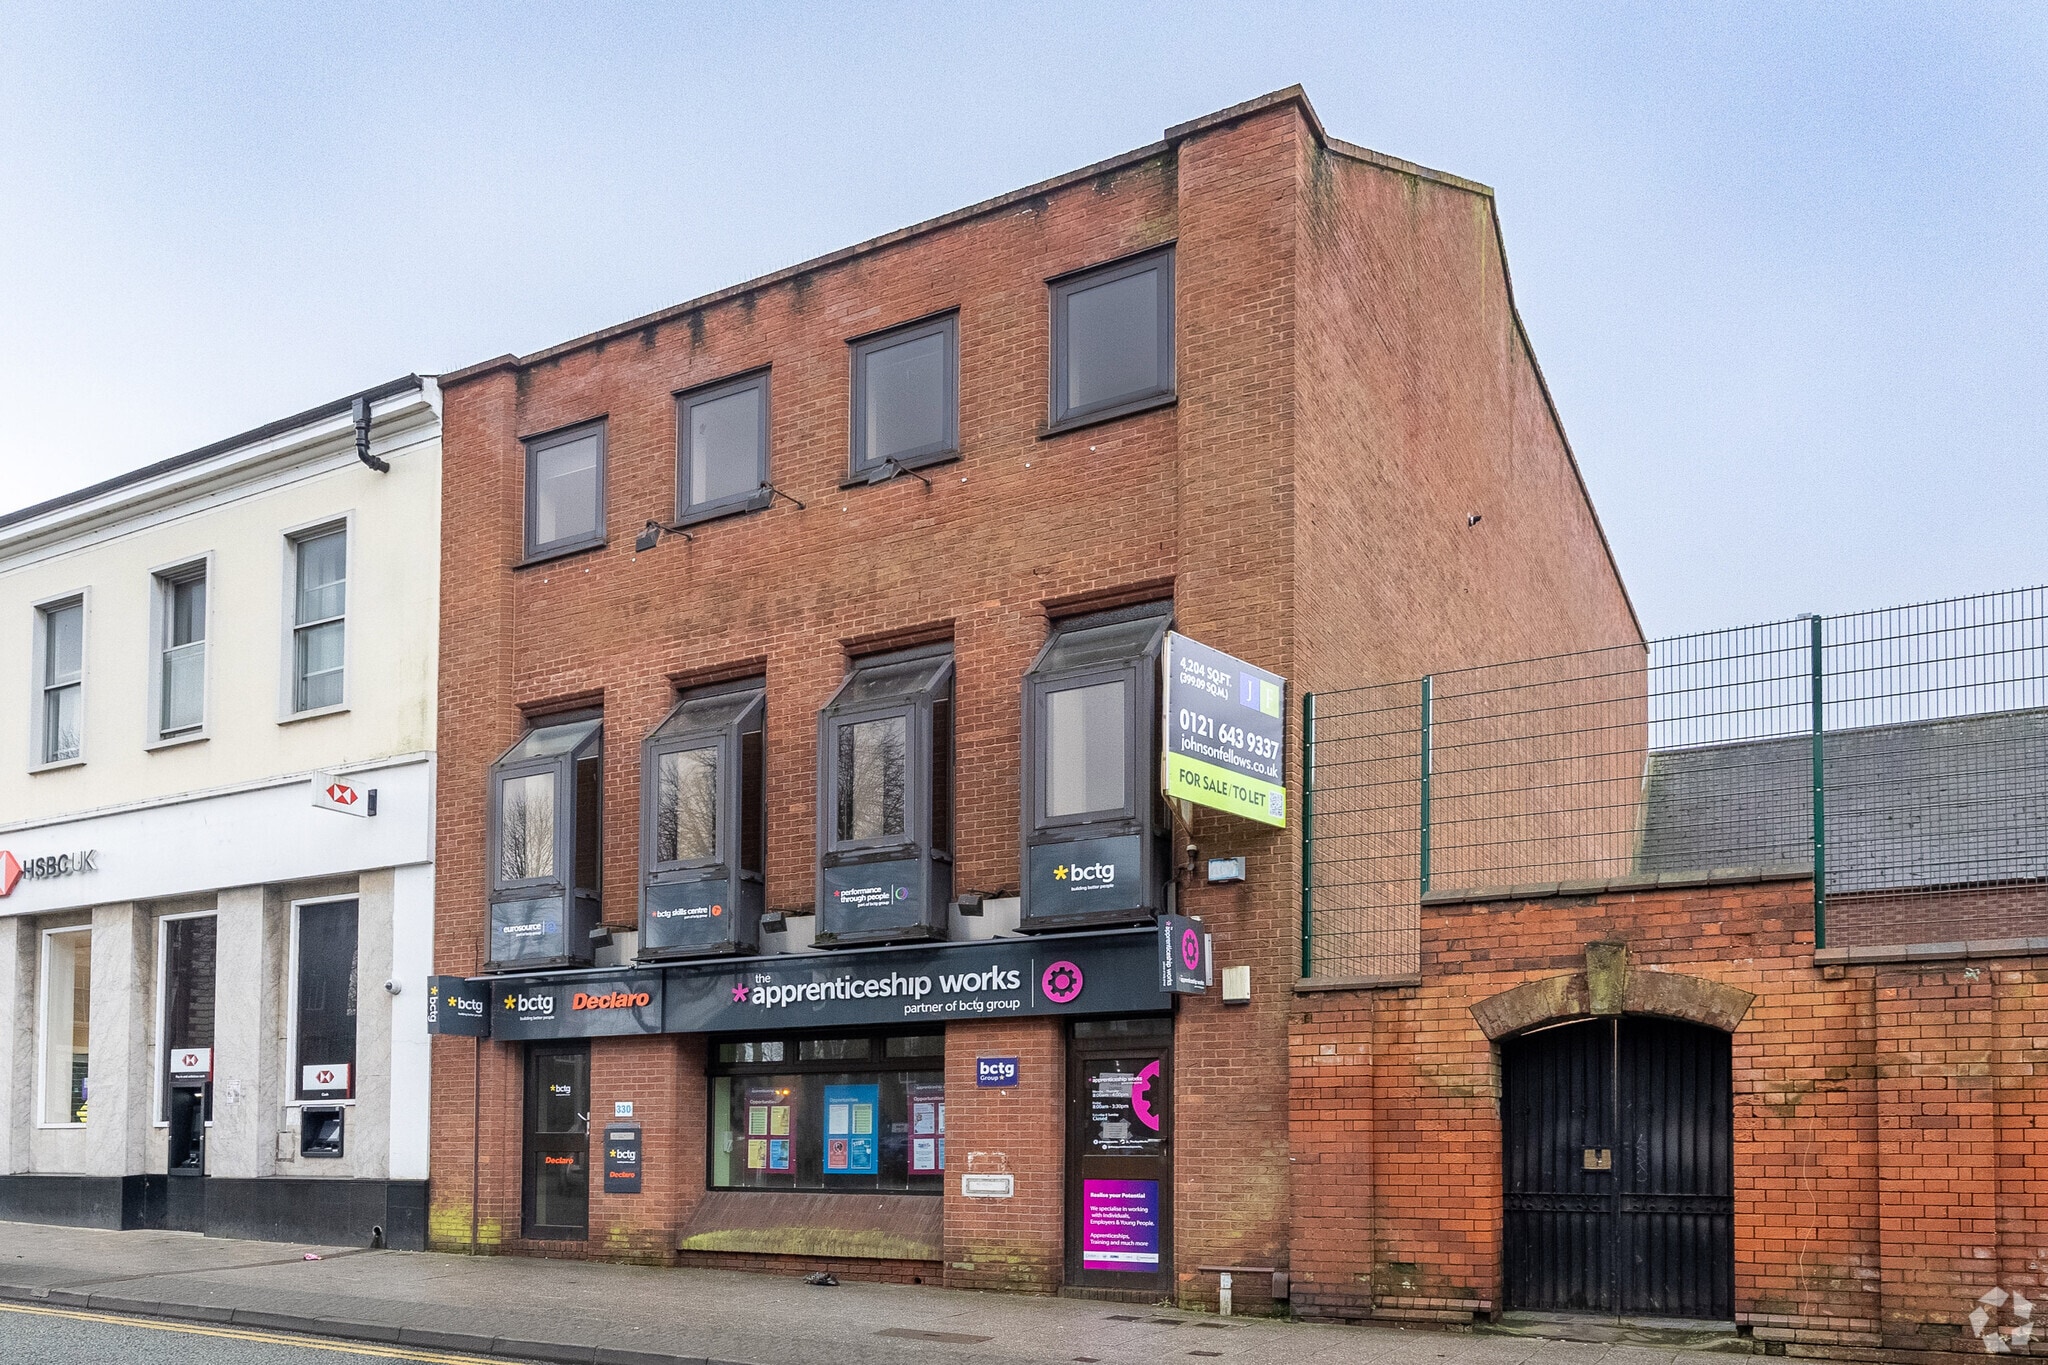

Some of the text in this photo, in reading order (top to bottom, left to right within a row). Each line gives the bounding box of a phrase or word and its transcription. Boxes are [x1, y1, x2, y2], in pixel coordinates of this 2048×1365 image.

[1180, 657, 1206, 677] 4,204
[1180, 672, 1206, 690] (399.09
[1180, 708, 1280, 760] 0121 643 9337
[1181, 735, 1278, 778] johnsonfellows.co.uk
[1180, 769, 1200, 788] FOR
[1249, 792, 1266, 806] LET
[23, 850, 98, 879] HSBC UK
[1071, 863, 1114, 882] bctg
[841, 887, 882, 896] performance
[867, 892, 890, 901] people
[657, 910, 672, 918] bctg
[672, 908, 687, 916] skills
[504, 924, 542, 933] eurosource
[752, 965, 1020, 1008] apprenticeship works
[755, 973, 771, 984] the
[428, 996, 438, 1022] bctg
[458, 997, 483, 1013] bctg
[518, 994, 554, 1014] bctg
[572, 992, 650, 1010] Declaro
[904, 998, 1020, 1016] partner of bctg group
[980, 1062, 1014, 1077] bctg
[556, 1084, 571, 1093] bctg
[616, 1104, 631, 1114] 330
[617, 1150, 635, 1160] bctg
